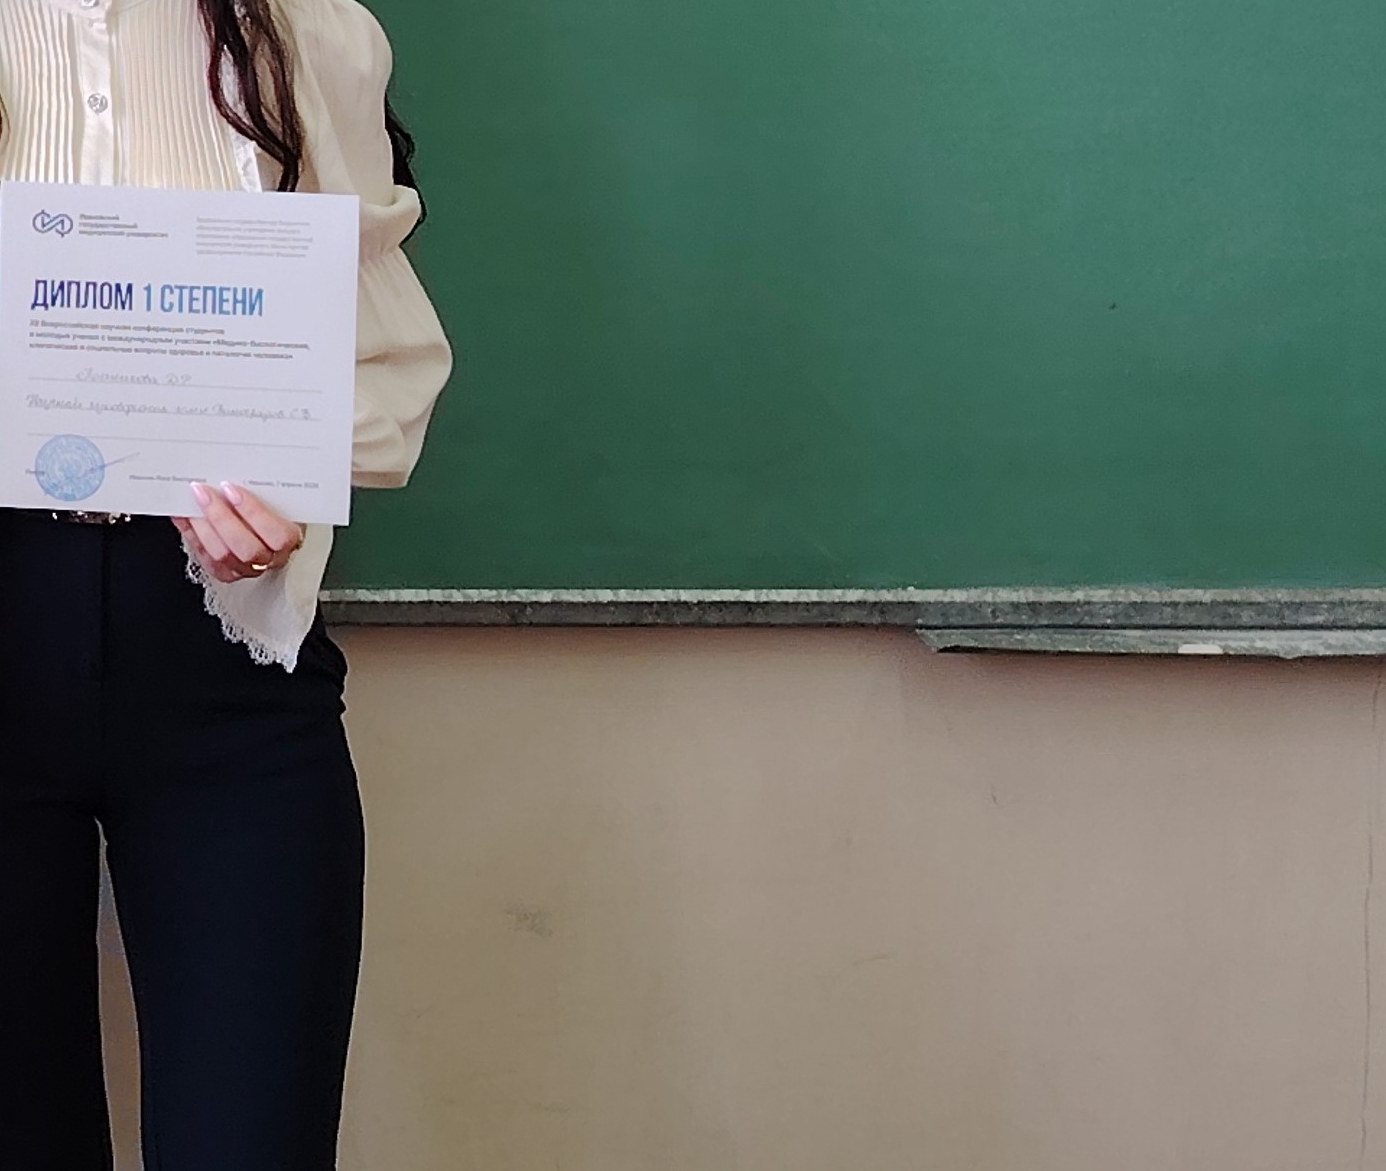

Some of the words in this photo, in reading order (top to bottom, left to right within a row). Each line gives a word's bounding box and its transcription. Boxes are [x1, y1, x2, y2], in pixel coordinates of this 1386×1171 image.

[30, 279, 133, 311] ДИПЛОМ
[143, 284, 152, 312] 1
[160, 284, 264, 317] СТЕПЕНИ
